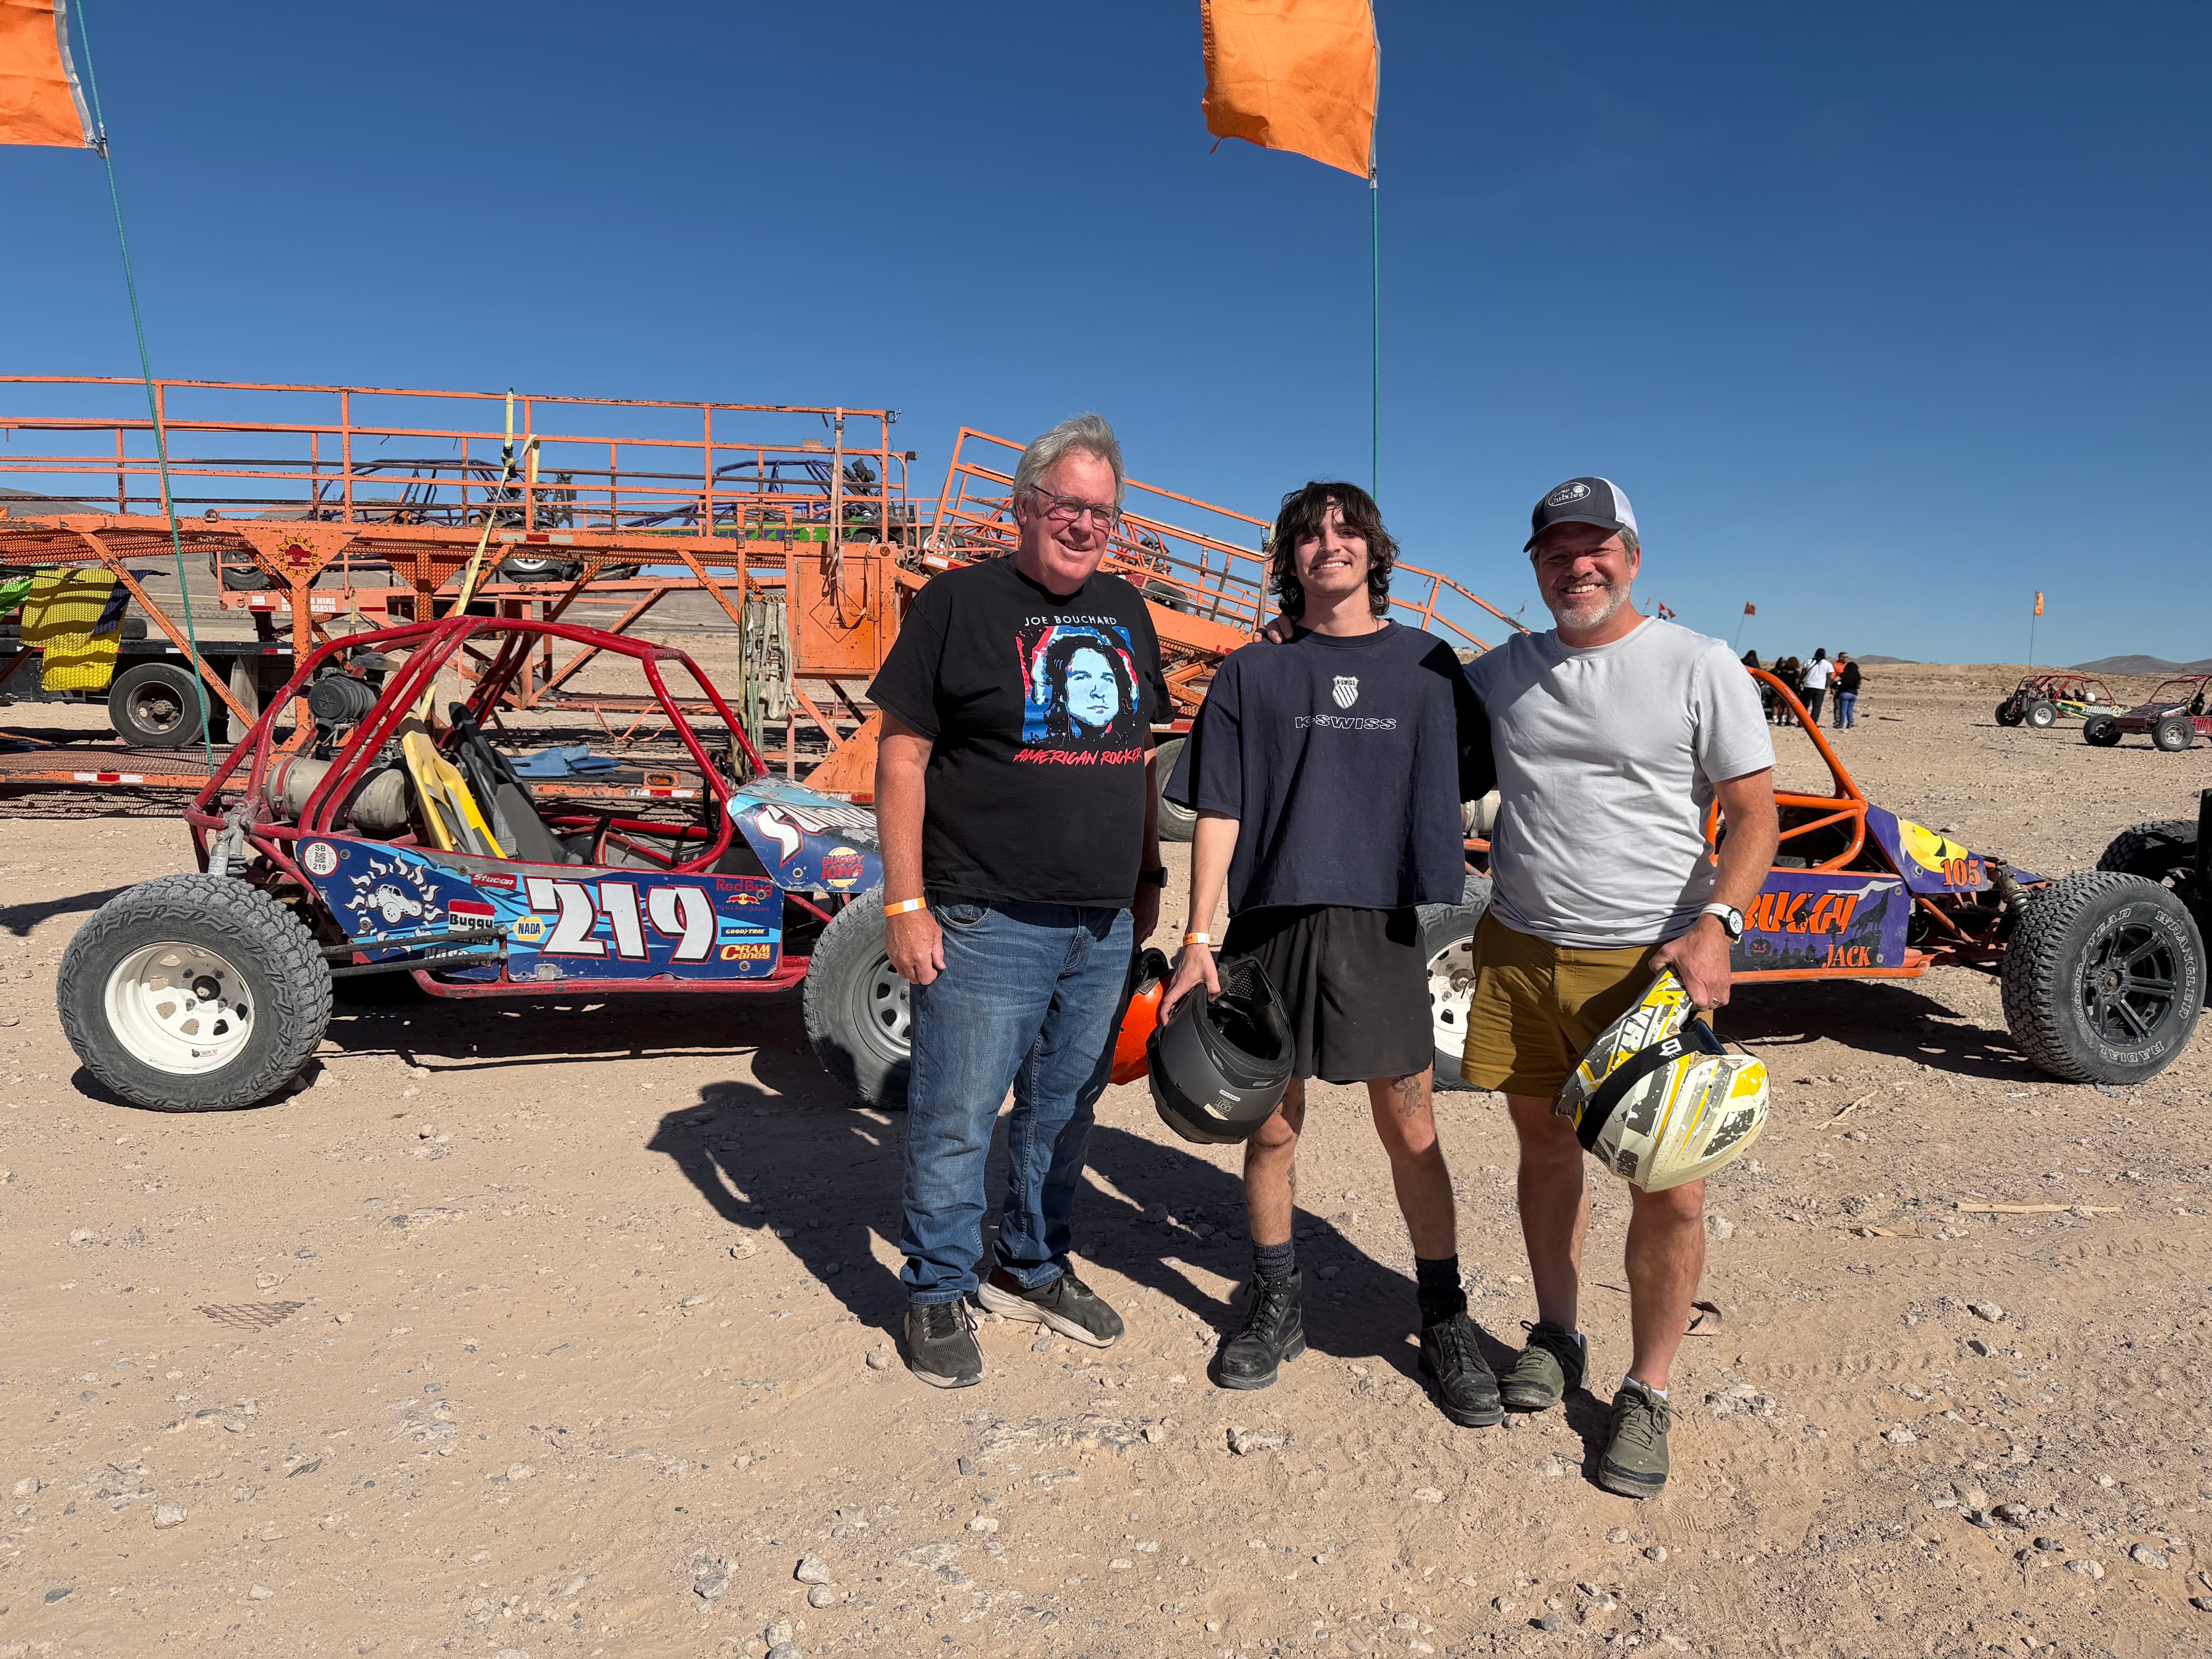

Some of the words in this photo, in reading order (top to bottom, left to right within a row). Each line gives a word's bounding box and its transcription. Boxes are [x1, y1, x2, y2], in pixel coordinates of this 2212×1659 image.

[1024, 616, 1048, 626] JOE
[1055, 615, 1117, 625] BOUCHARD
[1013, 748, 1099, 767] AMERICAN
[1100, 747, 1143, 766] ROCKER
[821, 854, 866, 867] BUGGY
[821, 864, 864, 881] KING
[1940, 858, 1982, 887] 105
[716, 878, 744, 892] Red
[745, 880, 773, 897] Bug
[518, 923, 541, 934] NADA
[523, 876, 717, 964] 219
[1821, 944, 1872, 969] JACK
[2154, 910, 2196, 1019] WRANGLER
[2100, 1041, 2165, 1062] RADIAL
